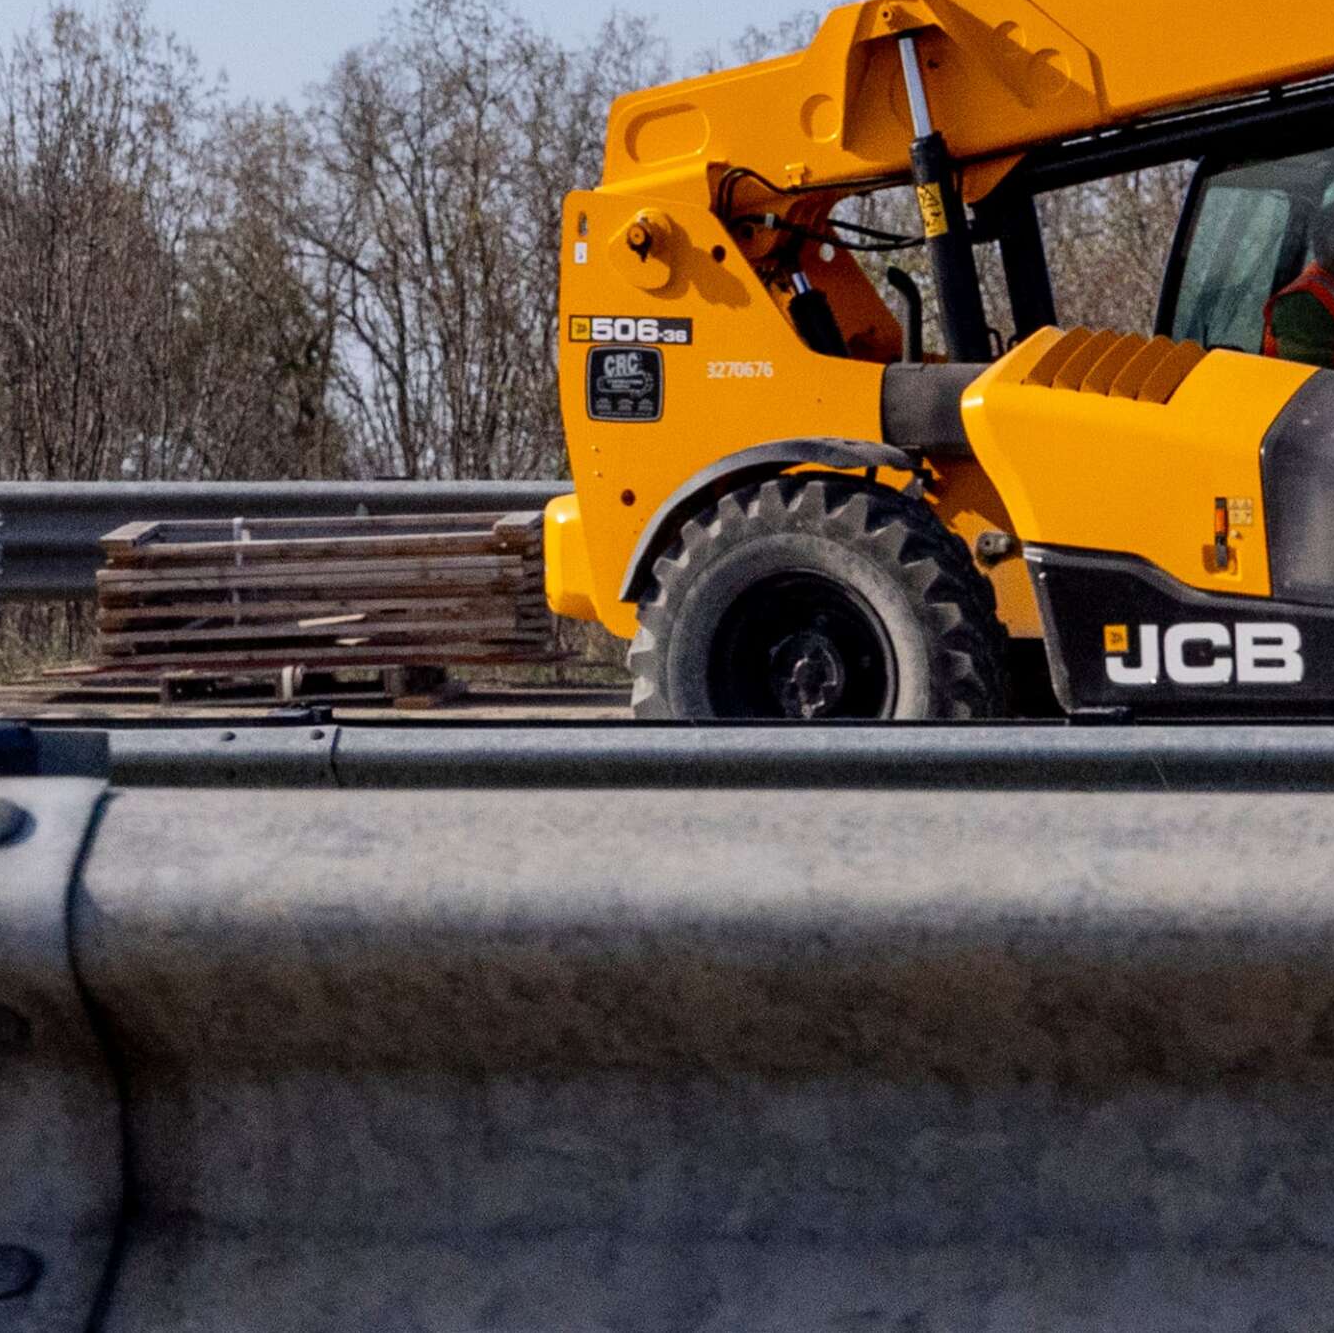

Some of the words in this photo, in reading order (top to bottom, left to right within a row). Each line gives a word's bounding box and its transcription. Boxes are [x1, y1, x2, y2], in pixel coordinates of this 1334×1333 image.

[603, 352, 638, 378] CRC
[706, 361, 774, 378] 3270676
[1104, 621, 1305, 685] JCB
